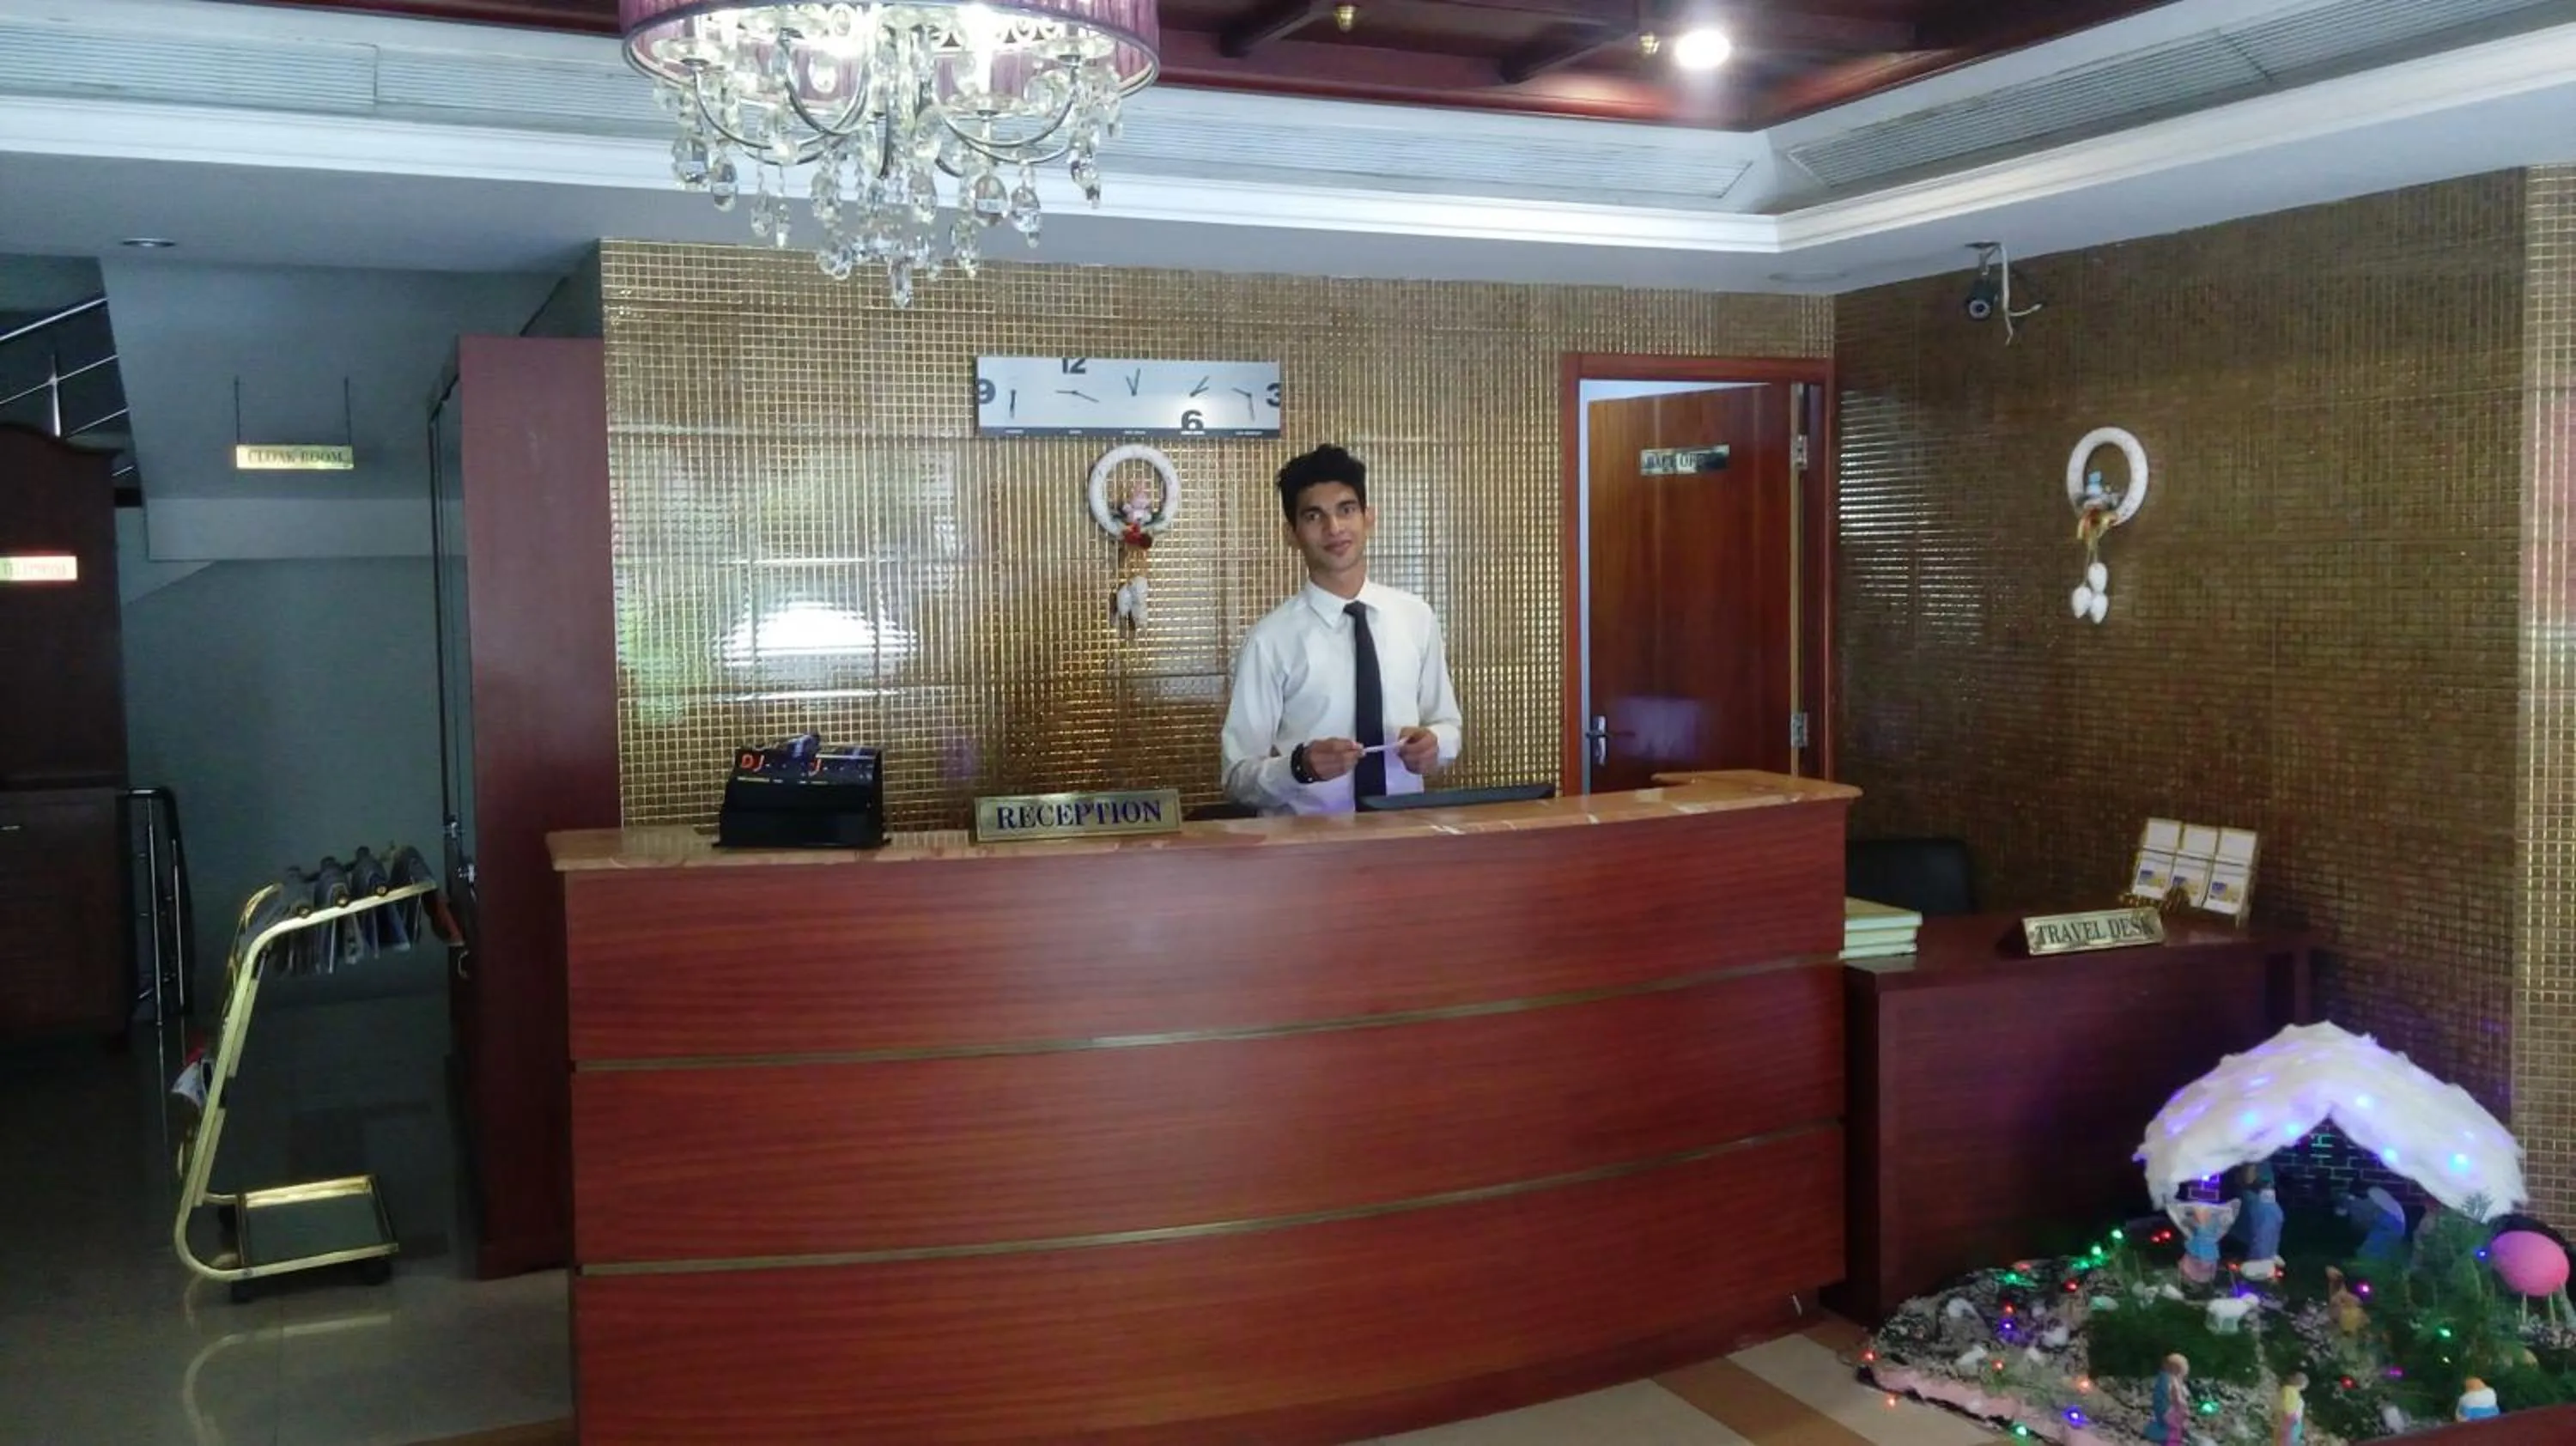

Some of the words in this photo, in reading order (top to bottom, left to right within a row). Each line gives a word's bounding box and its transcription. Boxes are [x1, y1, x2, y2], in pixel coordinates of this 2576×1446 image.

[978, 378, 996, 404] 9
[1266, 382, 1280, 407] 3
[1181, 409, 1204, 428] 6
[996, 800, 1163, 830] RECEPTION
[2034, 920, 2104, 946] TRAVEL
[2106, 915, 2157, 939] DESK
